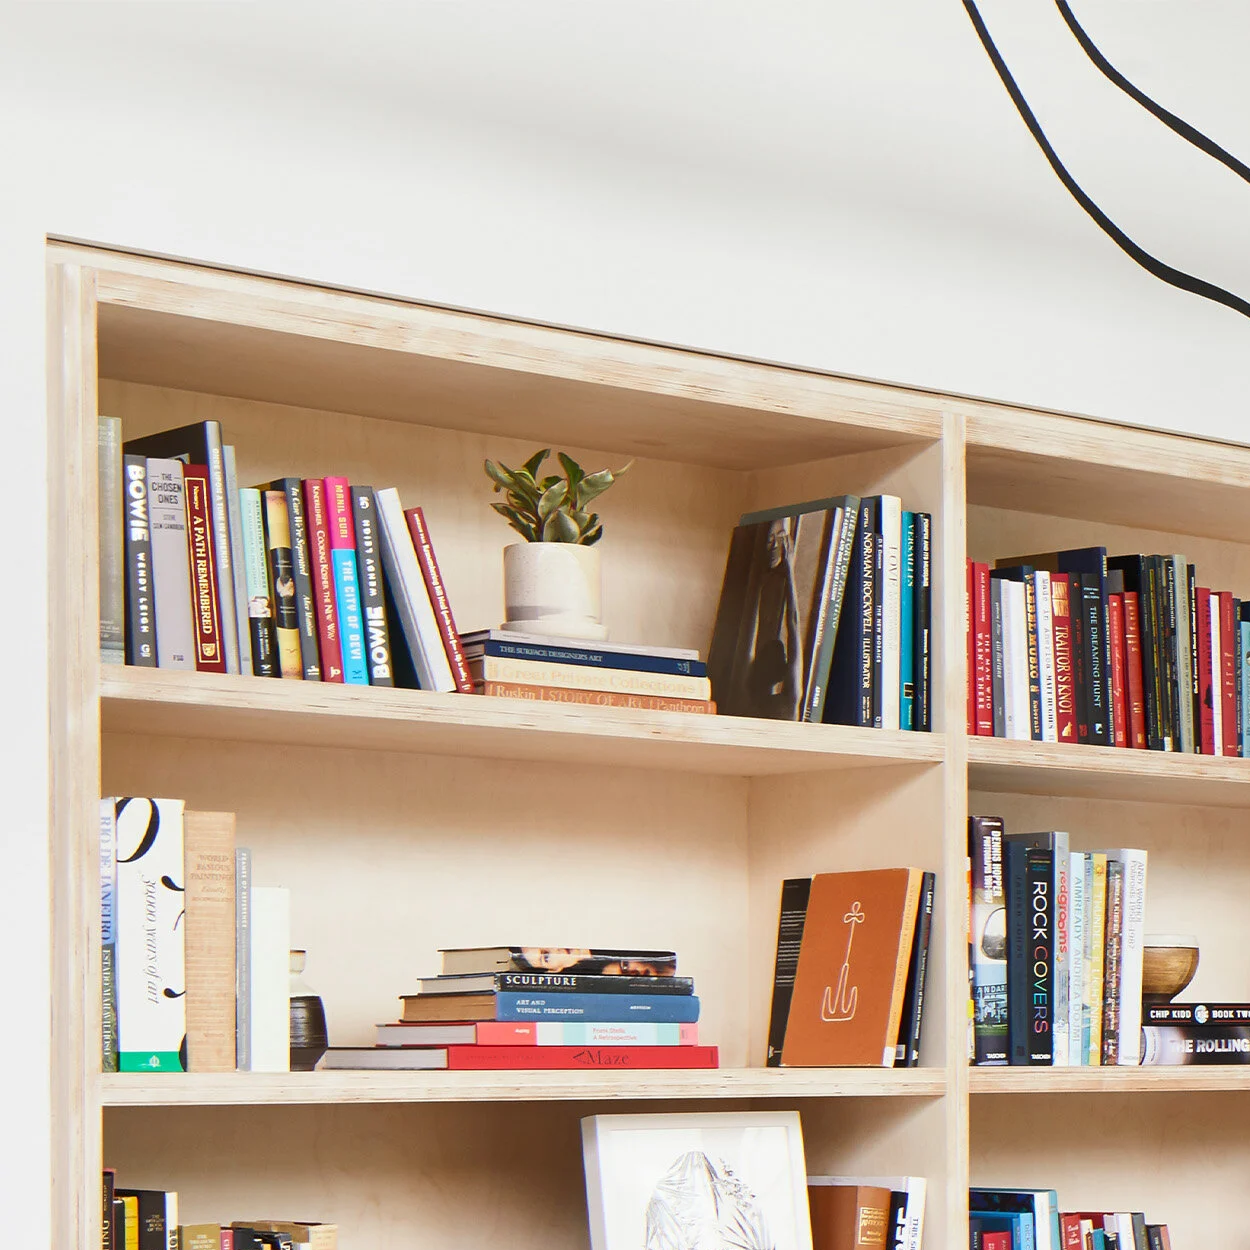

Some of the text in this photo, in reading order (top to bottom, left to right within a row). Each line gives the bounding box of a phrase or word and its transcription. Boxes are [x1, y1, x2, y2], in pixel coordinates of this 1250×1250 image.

[336, 485, 347, 537] MANIL SURI
[128, 465, 149, 633] BOWIE WENDY LEIGH
[194, 516, 212, 633] A PATH REMEMBERED
[342, 561, 361, 659] THE CITY OF DEVI
[1056, 625, 1072, 715] TRAITOR'S KNOT
[1091, 627, 1099, 677] DREAMING
[1093, 680, 1101, 708] HUNT
[101, 817, 112, 940] RIO DE JANEIRO
[991, 831, 1002, 896] DENNIS HOPPER
[142, 875, 163, 1004] 30,000 years of art
[1033, 882, 1048, 1033] ROCK COVERS
[506, 975, 577, 986] SCULPTURE
[1150, 1010, 1191, 1018] CHIP KIDD
[1196, 1040, 1250, 1052] ROLLING
[911, 1218, 919, 1238] THIS
